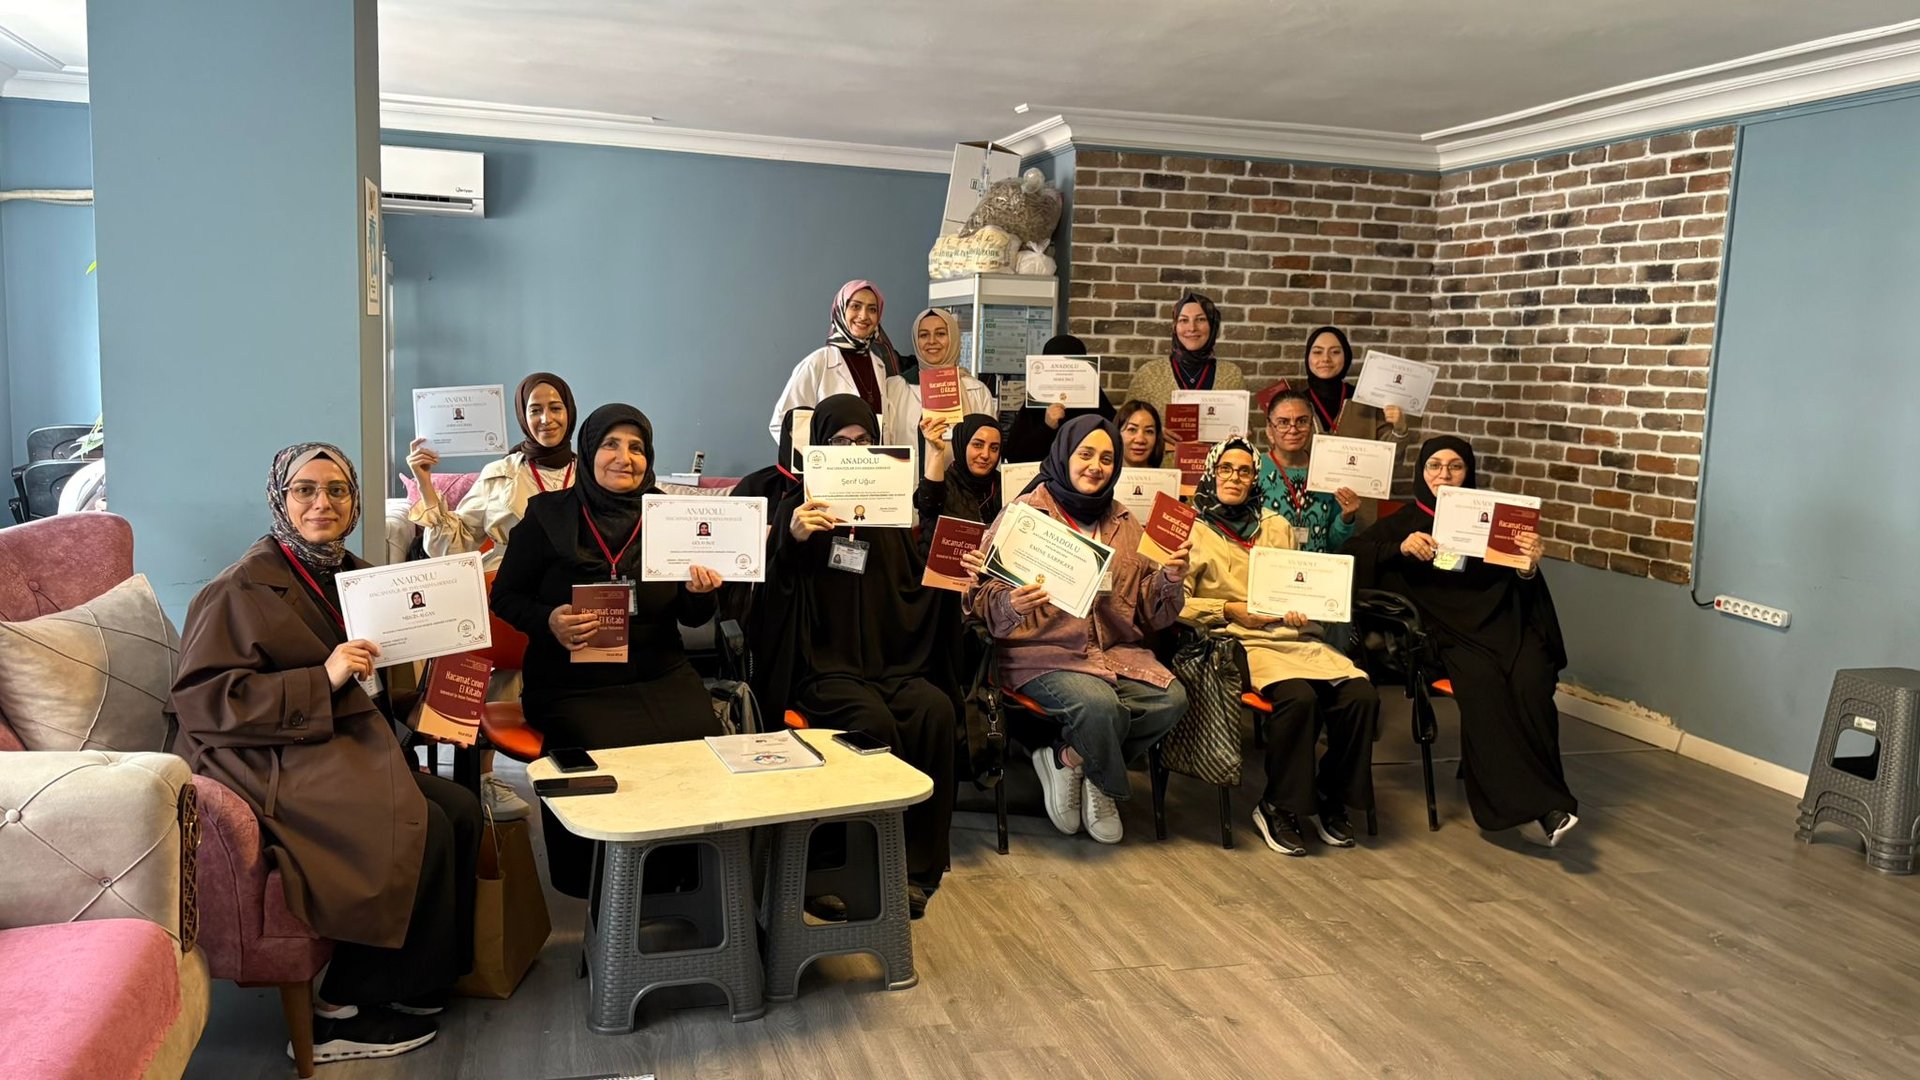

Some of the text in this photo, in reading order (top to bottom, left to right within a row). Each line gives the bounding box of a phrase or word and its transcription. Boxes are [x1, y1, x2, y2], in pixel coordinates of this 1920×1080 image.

[840, 457, 880, 465] ANADOLU
[858, 477, 876, 485] Uğur
[1043, 530, 1081, 554] ANADOLU
[392, 571, 439, 587] ANADOLU
[445, 671, 485, 689] Hacamat'cının
[459, 684, 466, 693] El
[465, 686, 483, 698] Kitabı
